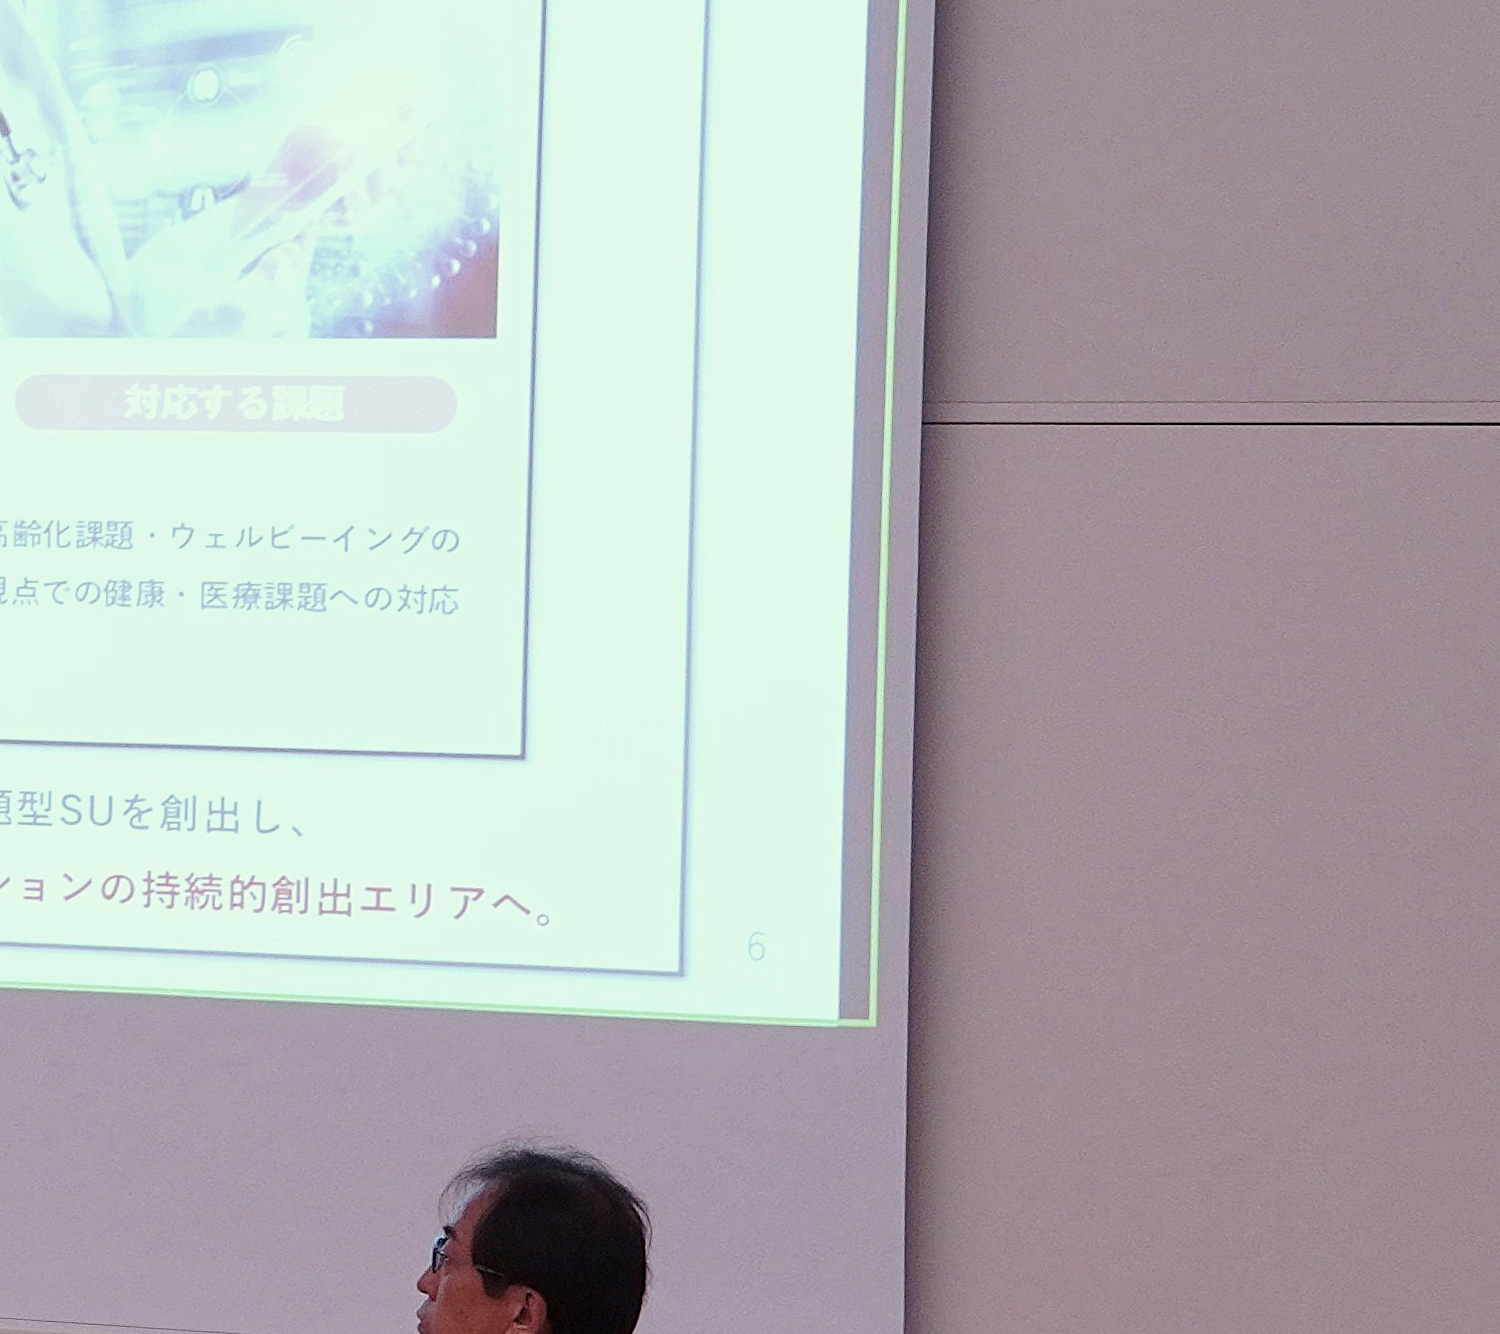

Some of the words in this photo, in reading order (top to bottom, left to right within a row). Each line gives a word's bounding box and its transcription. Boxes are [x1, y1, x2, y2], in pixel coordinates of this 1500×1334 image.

[123, 383, 346, 423] 対応する課題
[747, 930, 766, 962] 6
